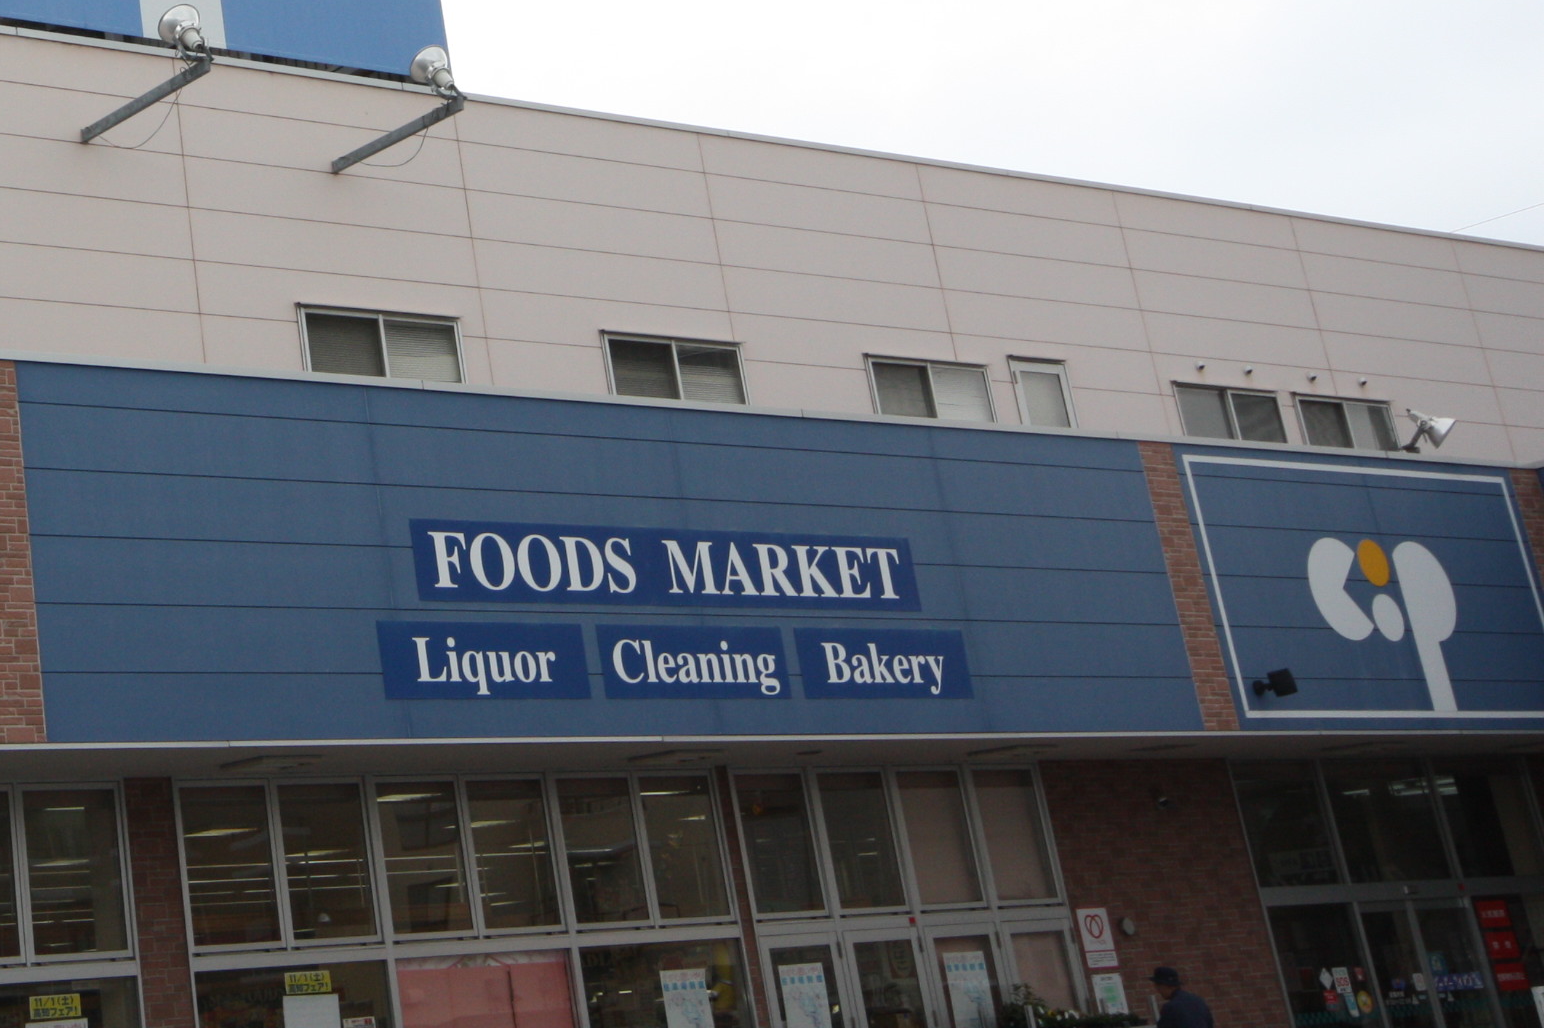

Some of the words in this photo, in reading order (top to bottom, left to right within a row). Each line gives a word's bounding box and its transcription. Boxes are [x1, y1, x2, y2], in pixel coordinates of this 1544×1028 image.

[427, 531, 637, 594] FOODS
[661, 539, 900, 599] MARKET
[412, 637, 556, 695] Liquor
[612, 639, 781, 695] Cleaning
[821, 641, 944, 694] Bakery
